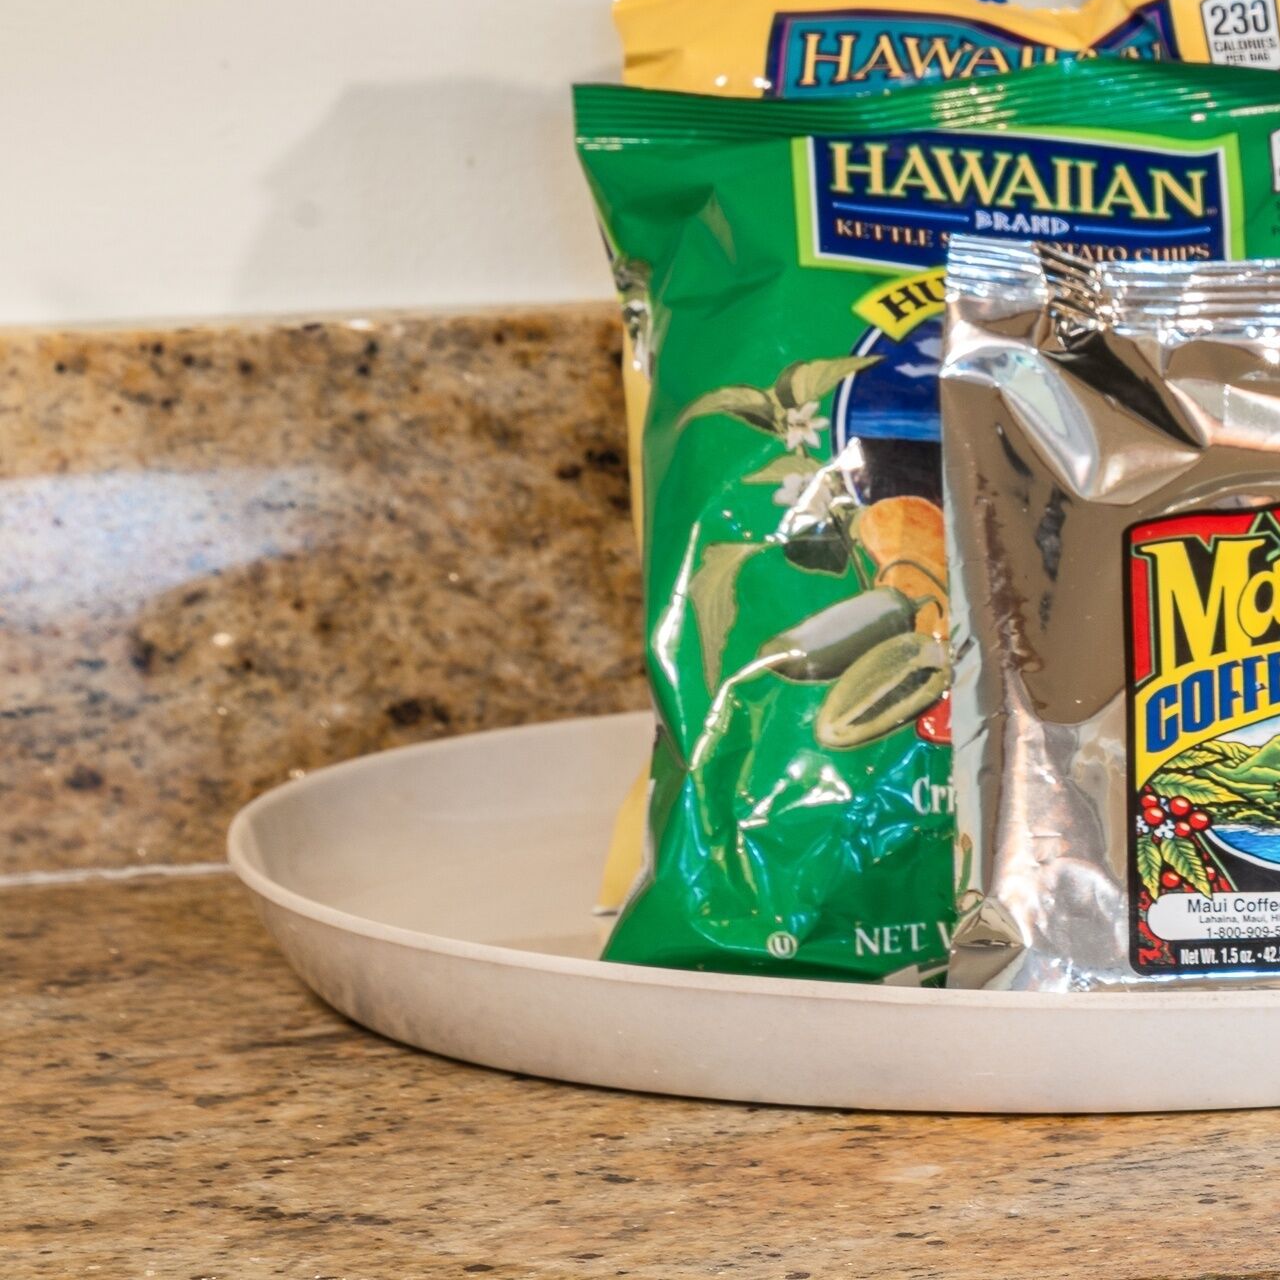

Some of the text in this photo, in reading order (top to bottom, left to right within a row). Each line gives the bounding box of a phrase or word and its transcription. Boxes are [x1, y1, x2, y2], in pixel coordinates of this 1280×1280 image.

[1211, 0, 1270, 36] 230
[829, 141, 1207, 219] HAWAIIAN
[836, 218, 933, 248] KETTLE
[975, 210, 1069, 236] BRAND
[1134, 242, 1211, 261] CHIPS
[912, 776, 956, 815] Cri
[1187, 898, 1227, 914] Maui
[1271, 913, 1280, 922] HI
[855, 922, 926, 956] NET
[1180, 949, 1199, 965] Net
[1201, 948, 1218, 964] Wt.
[1221, 947, 1239, 964] 1.5
[1240, 951, 1255, 964] oz.
